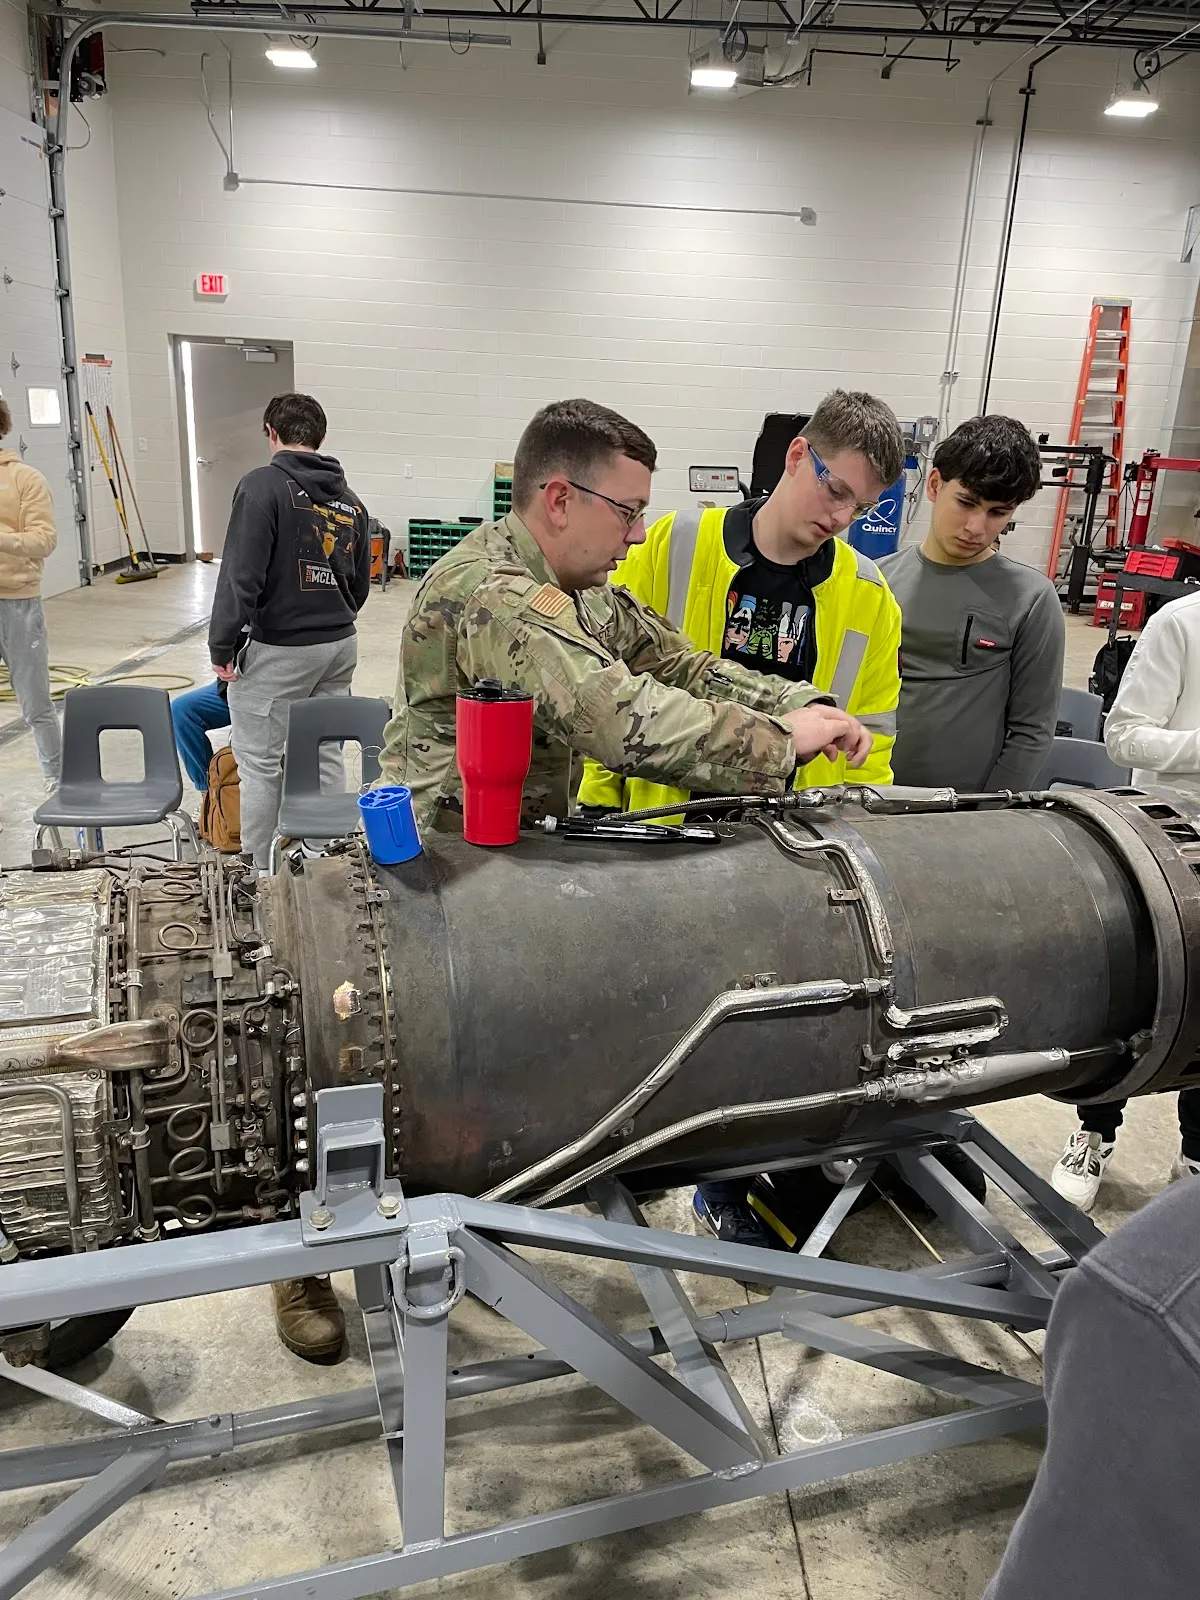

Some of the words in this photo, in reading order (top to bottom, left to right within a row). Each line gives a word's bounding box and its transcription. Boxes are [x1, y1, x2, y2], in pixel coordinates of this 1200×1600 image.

[202, 274, 224, 293] EXIT
[862, 523, 897, 533] Quincy
[311, 570, 338, 586] MCL6
